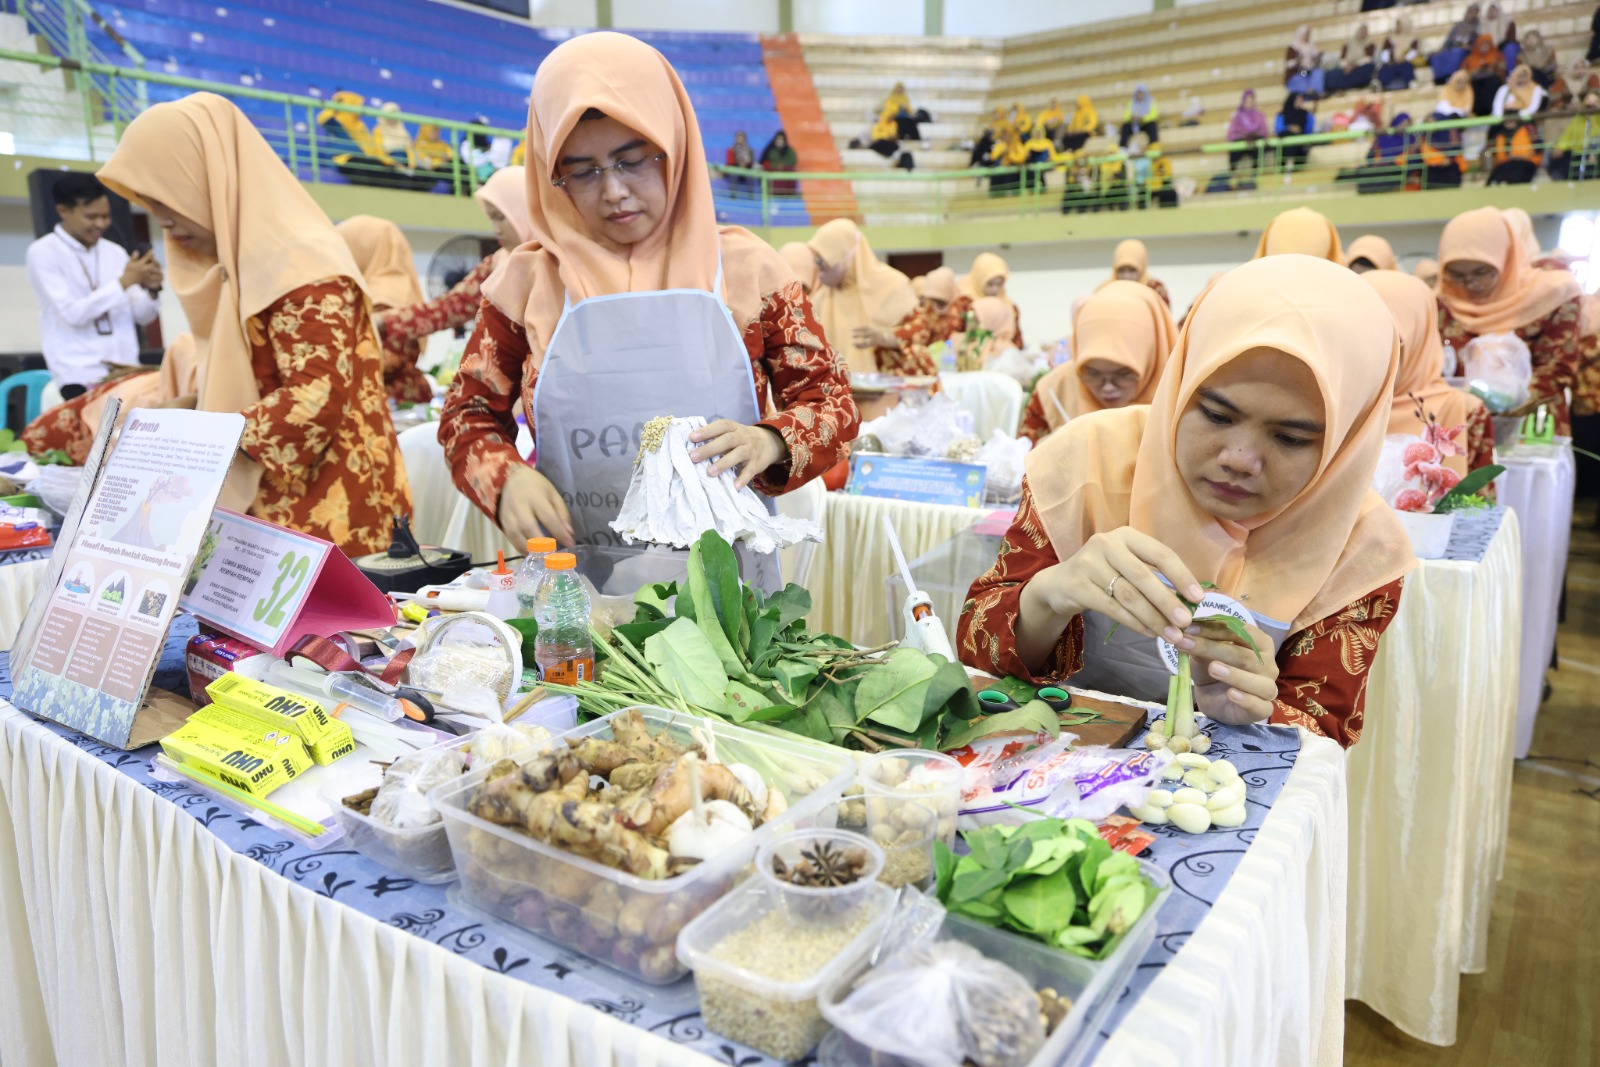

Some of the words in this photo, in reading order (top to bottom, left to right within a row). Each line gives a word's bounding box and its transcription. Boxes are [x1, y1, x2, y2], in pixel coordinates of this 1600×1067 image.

[129, 419, 160, 432] Bromo
[81, 540, 100, 550] Filosofi
[100, 544, 120, 556] Rempah
[121, 548, 141, 560] Bentuk
[141, 554, 162, 566] Gunung
[162, 558, 181, 569] Bromo
[222, 558, 237, 568] LOMBA
[237, 563, 262, 577] MERANGKAI
[253, 550, 310, 629] 32
[264, 696, 308, 718] UHU
[313, 705, 328, 726] UHU
[220, 750, 264, 773] UHU
[332, 744, 353, 760] UHU
[251, 764, 274, 783] UHU
[282, 758, 296, 778] UHU
[220, 772, 251, 793] UHU
